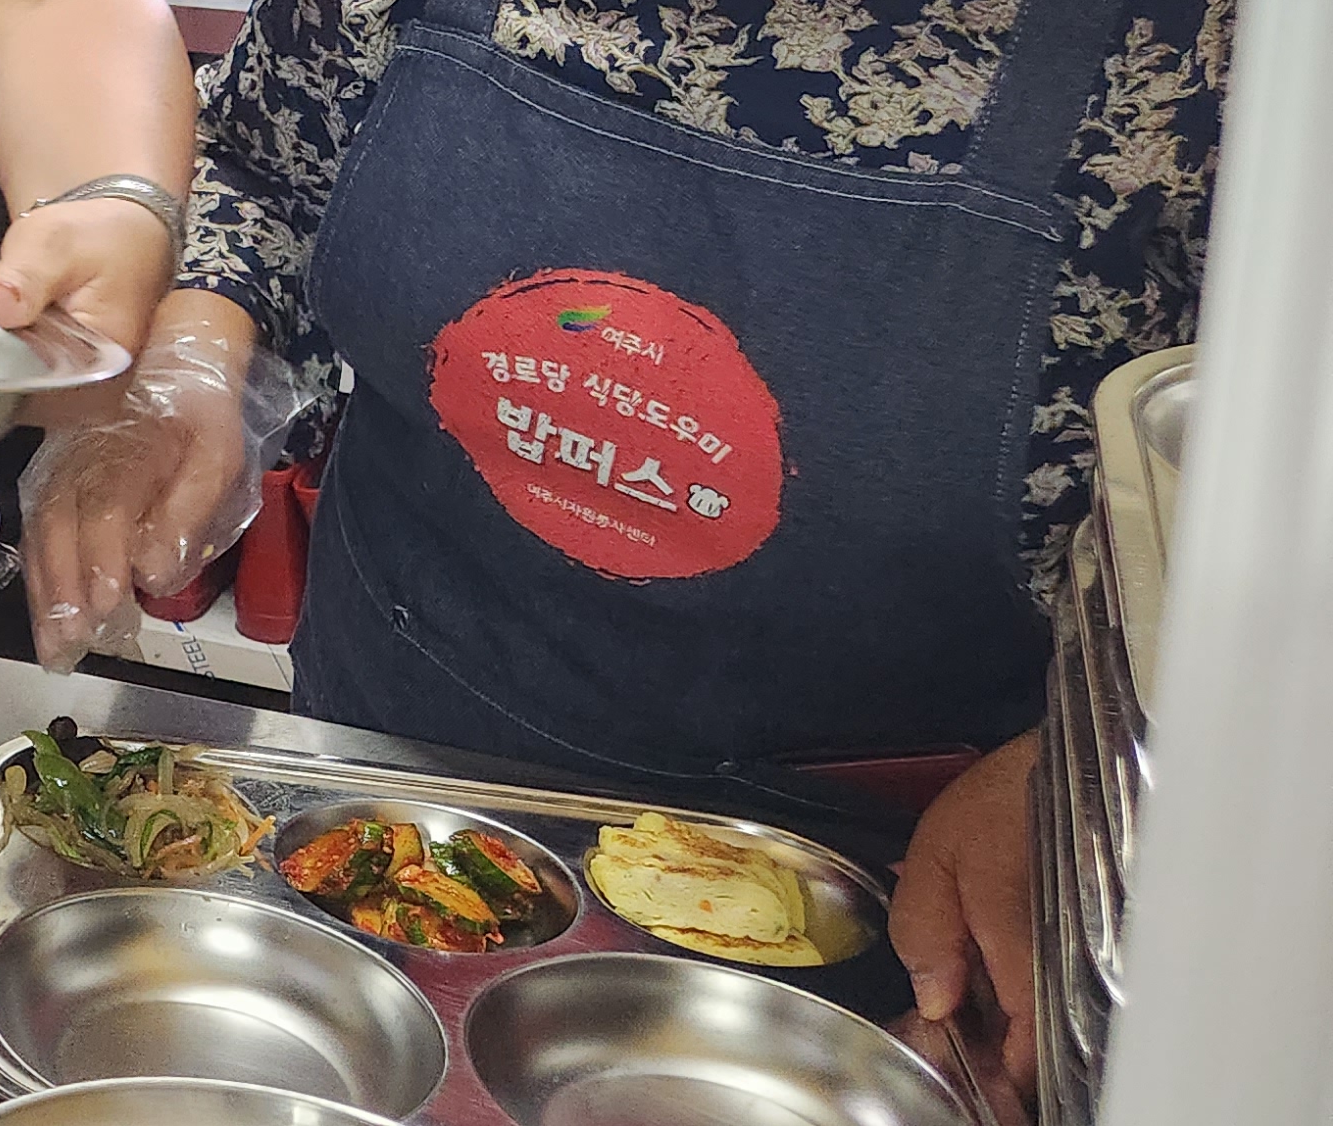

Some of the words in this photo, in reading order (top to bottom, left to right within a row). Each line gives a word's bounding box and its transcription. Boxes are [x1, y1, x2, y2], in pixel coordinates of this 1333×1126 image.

[601, 326, 665, 366] 여주시
[481, 351, 571, 393] 경로당
[582, 373, 733, 465] 식당도우미
[497, 396, 679, 512] 밥퍼스
[525, 483, 657, 549] 여주시자원봉사센터
